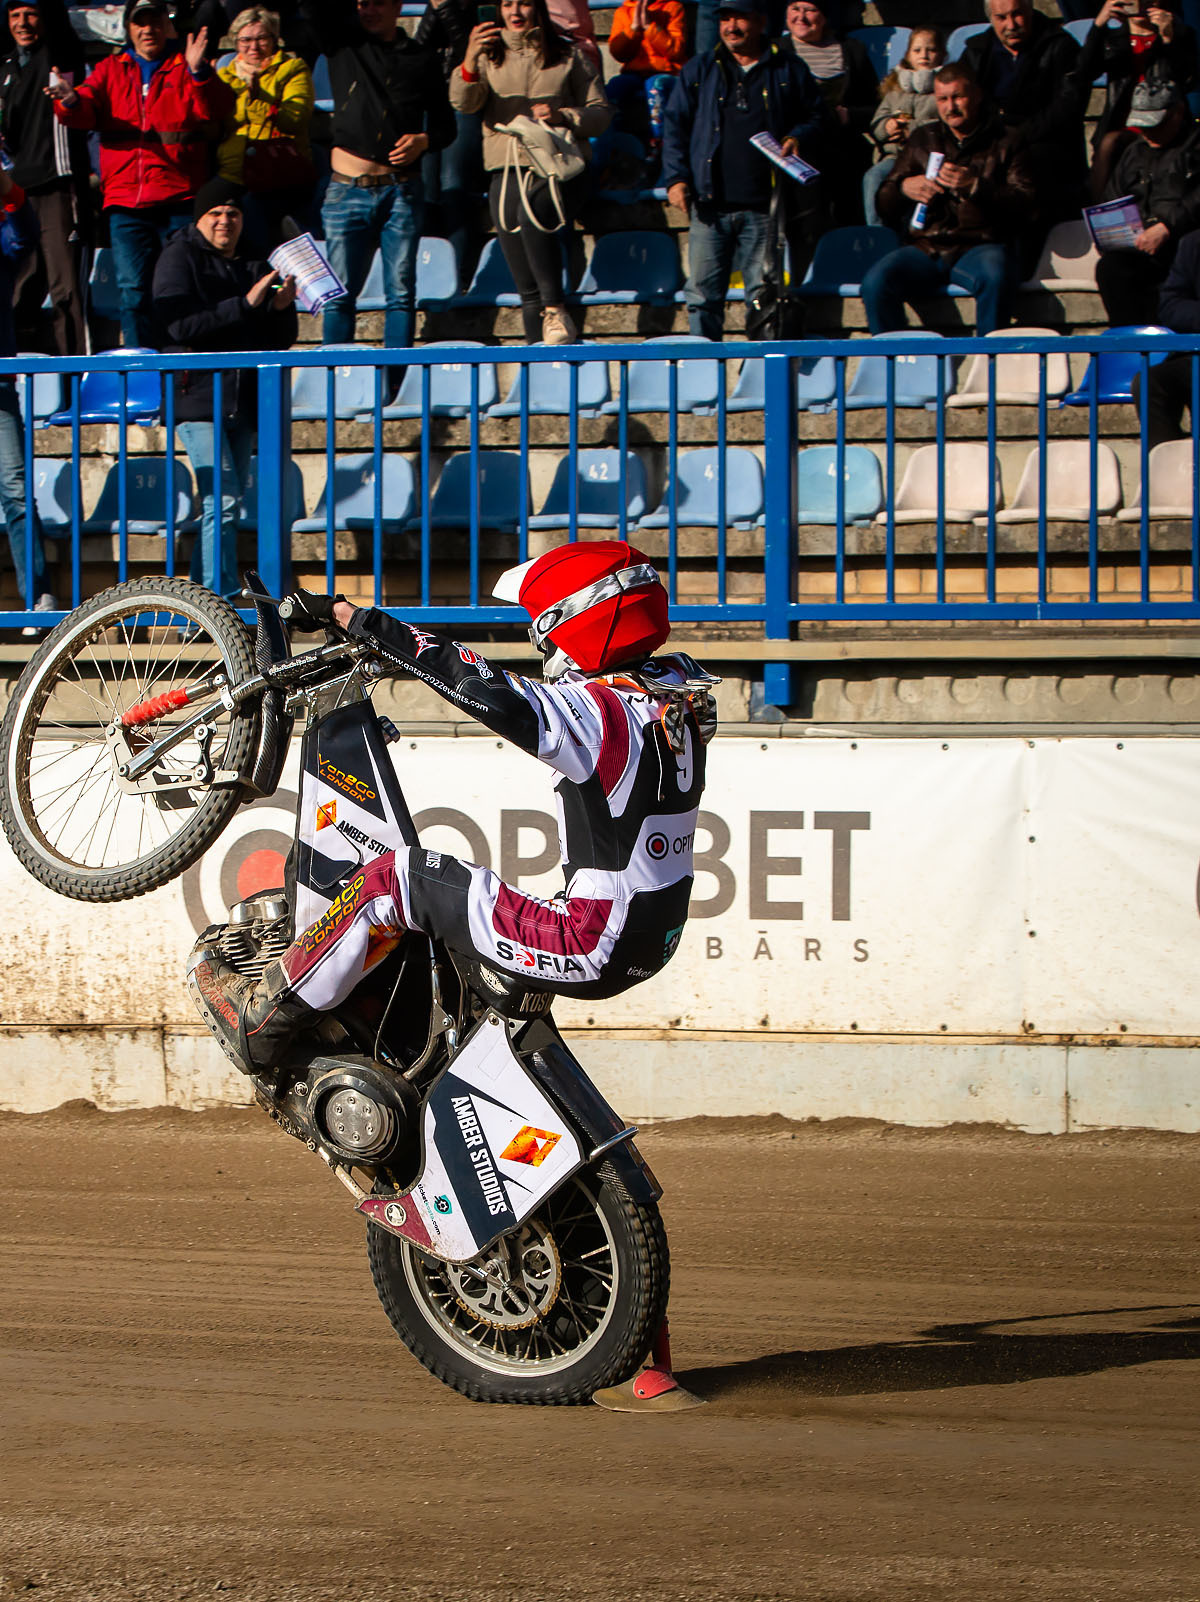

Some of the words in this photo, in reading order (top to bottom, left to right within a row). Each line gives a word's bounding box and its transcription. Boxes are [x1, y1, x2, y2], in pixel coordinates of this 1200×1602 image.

[589, 462, 609, 480] 42
[381, 650, 489, 713] www.qatar2022events.com
[673, 723, 694, 793] 9
[319, 768, 367, 803] LONDON
[336, 820, 370, 846] AMBER
[367, 838, 393, 857] STU
[706, 930, 869, 962] BĀRS
[626, 965, 653, 979] ticket
[450, 1095, 482, 1150] AMBER
[469, 1147, 508, 1217] STUDIOS
[417, 1183, 441, 1236] ticketkosta.com
